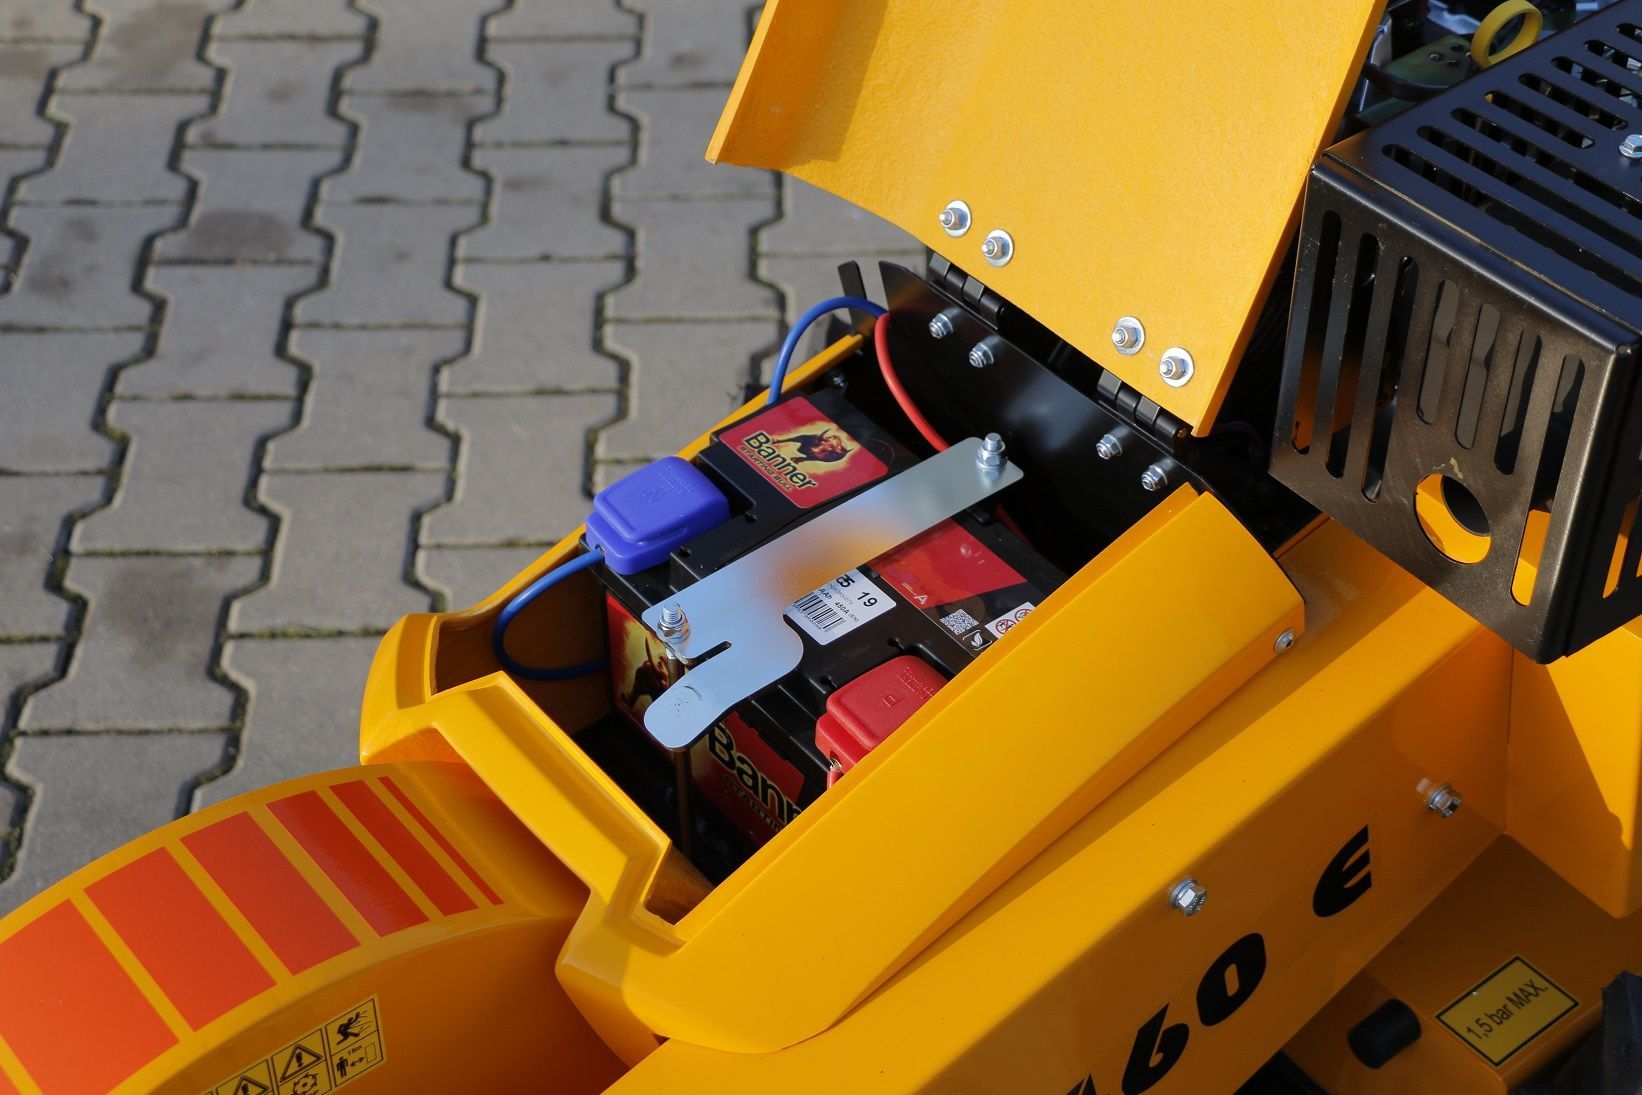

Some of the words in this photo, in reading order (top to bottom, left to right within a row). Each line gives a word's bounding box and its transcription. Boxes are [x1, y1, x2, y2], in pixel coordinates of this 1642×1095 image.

[739, 445, 775, 475] STARTING
[774, 474, 793, 492] BULL
[743, 430, 818, 489] Banner
[835, 602, 850, 615] 450A
[857, 591, 878, 607] 19
[1066, 932, 1267, 1095] 60
[1313, 824, 1373, 918] E
[1466, 1018, 1493, 1039] 1,5
[1484, 1003, 1514, 1026] bar
